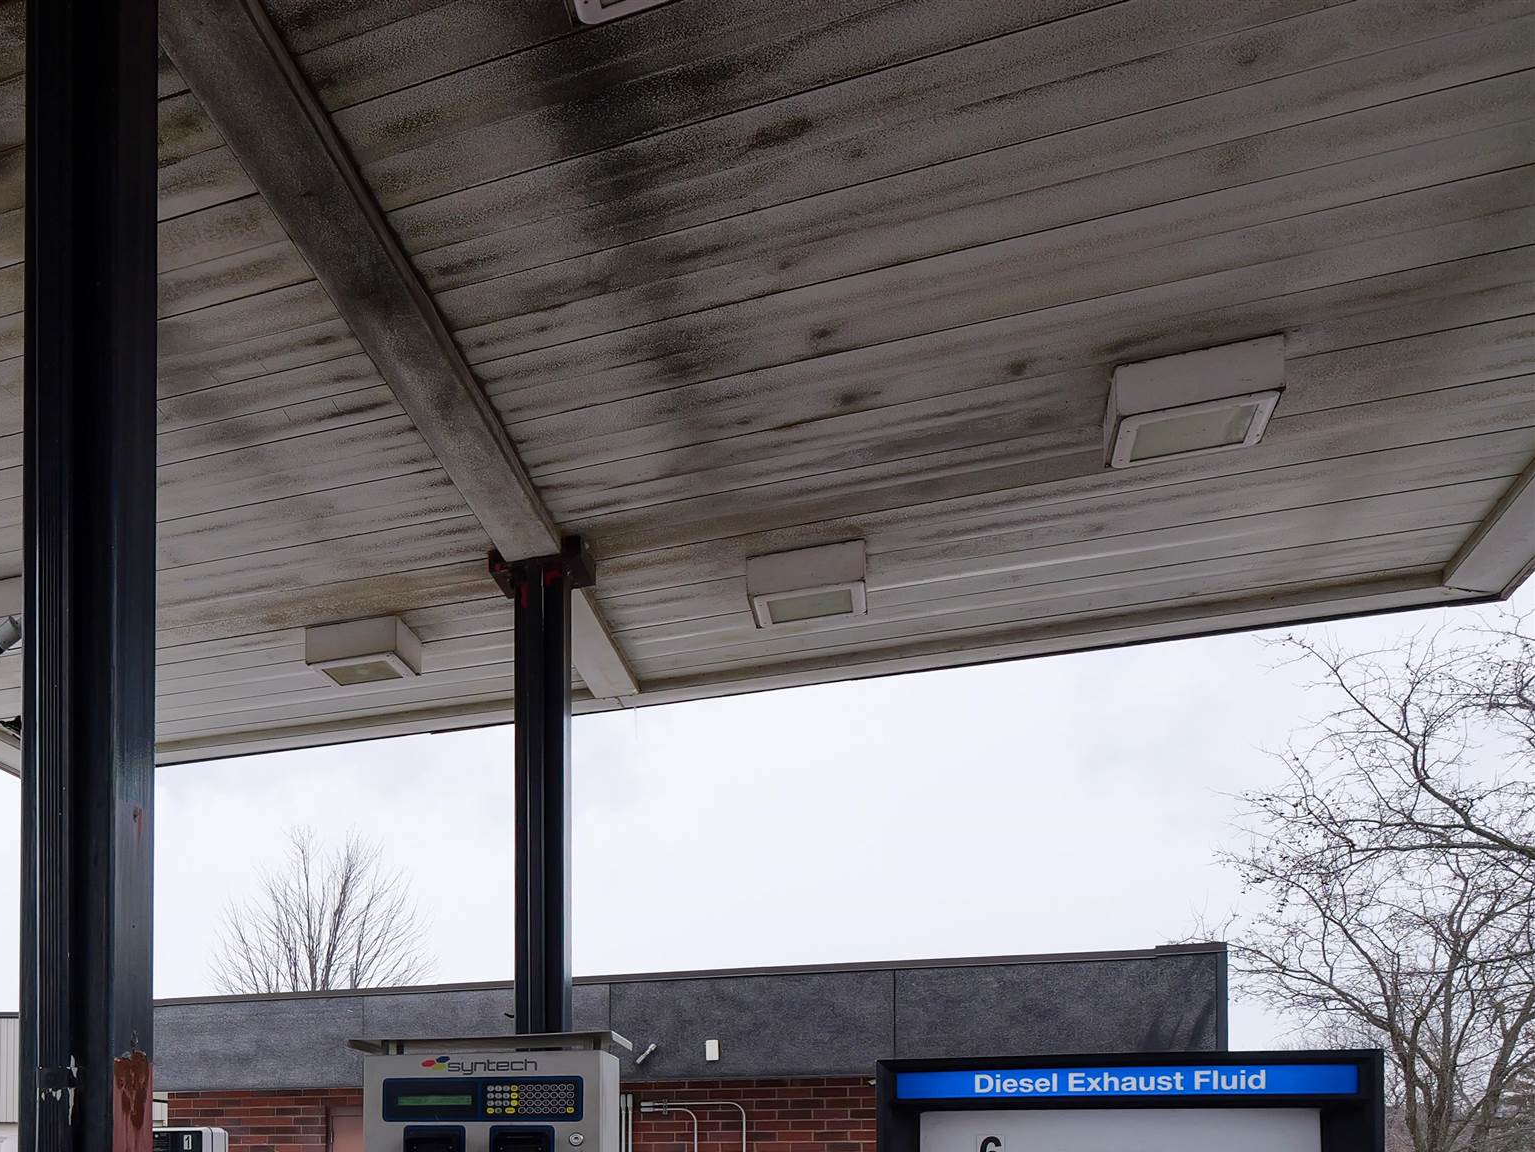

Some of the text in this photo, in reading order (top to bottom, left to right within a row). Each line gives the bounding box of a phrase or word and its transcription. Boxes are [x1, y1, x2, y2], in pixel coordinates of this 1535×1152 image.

[447, 1058, 538, 1075] syntech
[974, 1069, 1267, 1094] Diesel Exhaust Fluid
